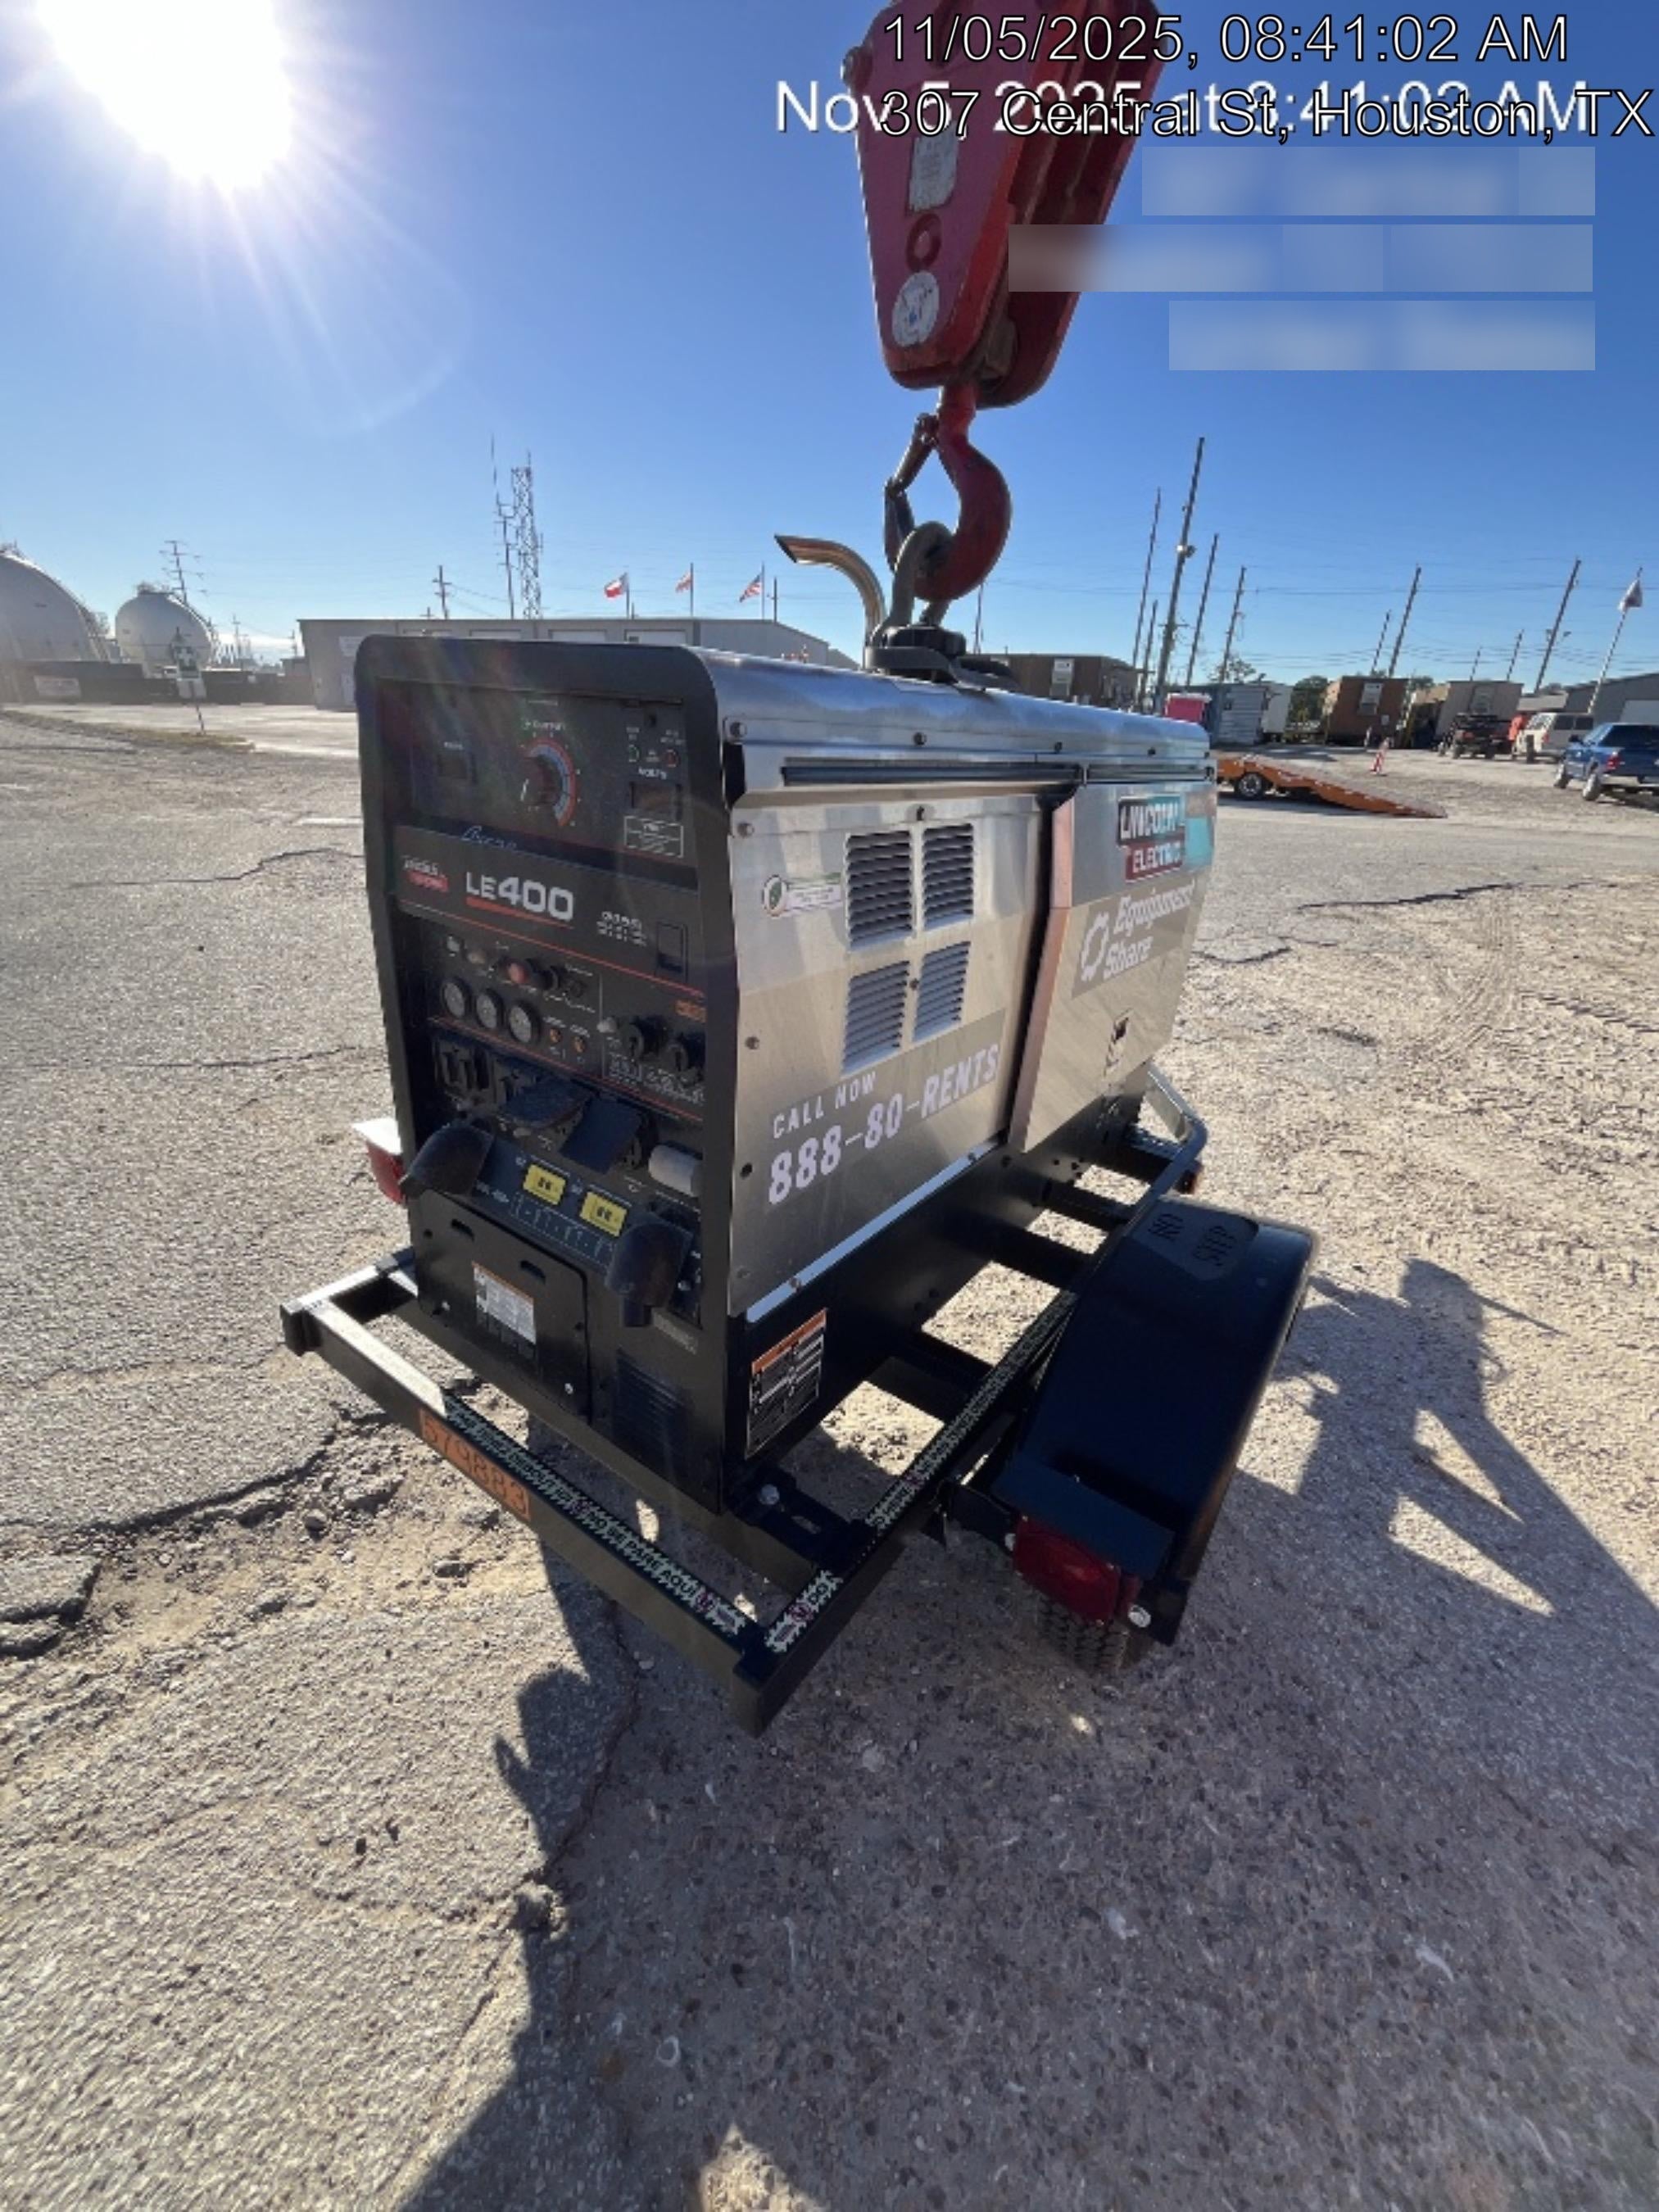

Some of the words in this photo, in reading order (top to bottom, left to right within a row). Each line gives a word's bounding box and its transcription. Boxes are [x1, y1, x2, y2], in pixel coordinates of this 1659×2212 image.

[465, 871, 574, 922] LE400
[768, 1043, 999, 1205] 888-80-RENTS
[773, 1095, 824, 1140] CALL
[834, 1070, 877, 1109] NOW
